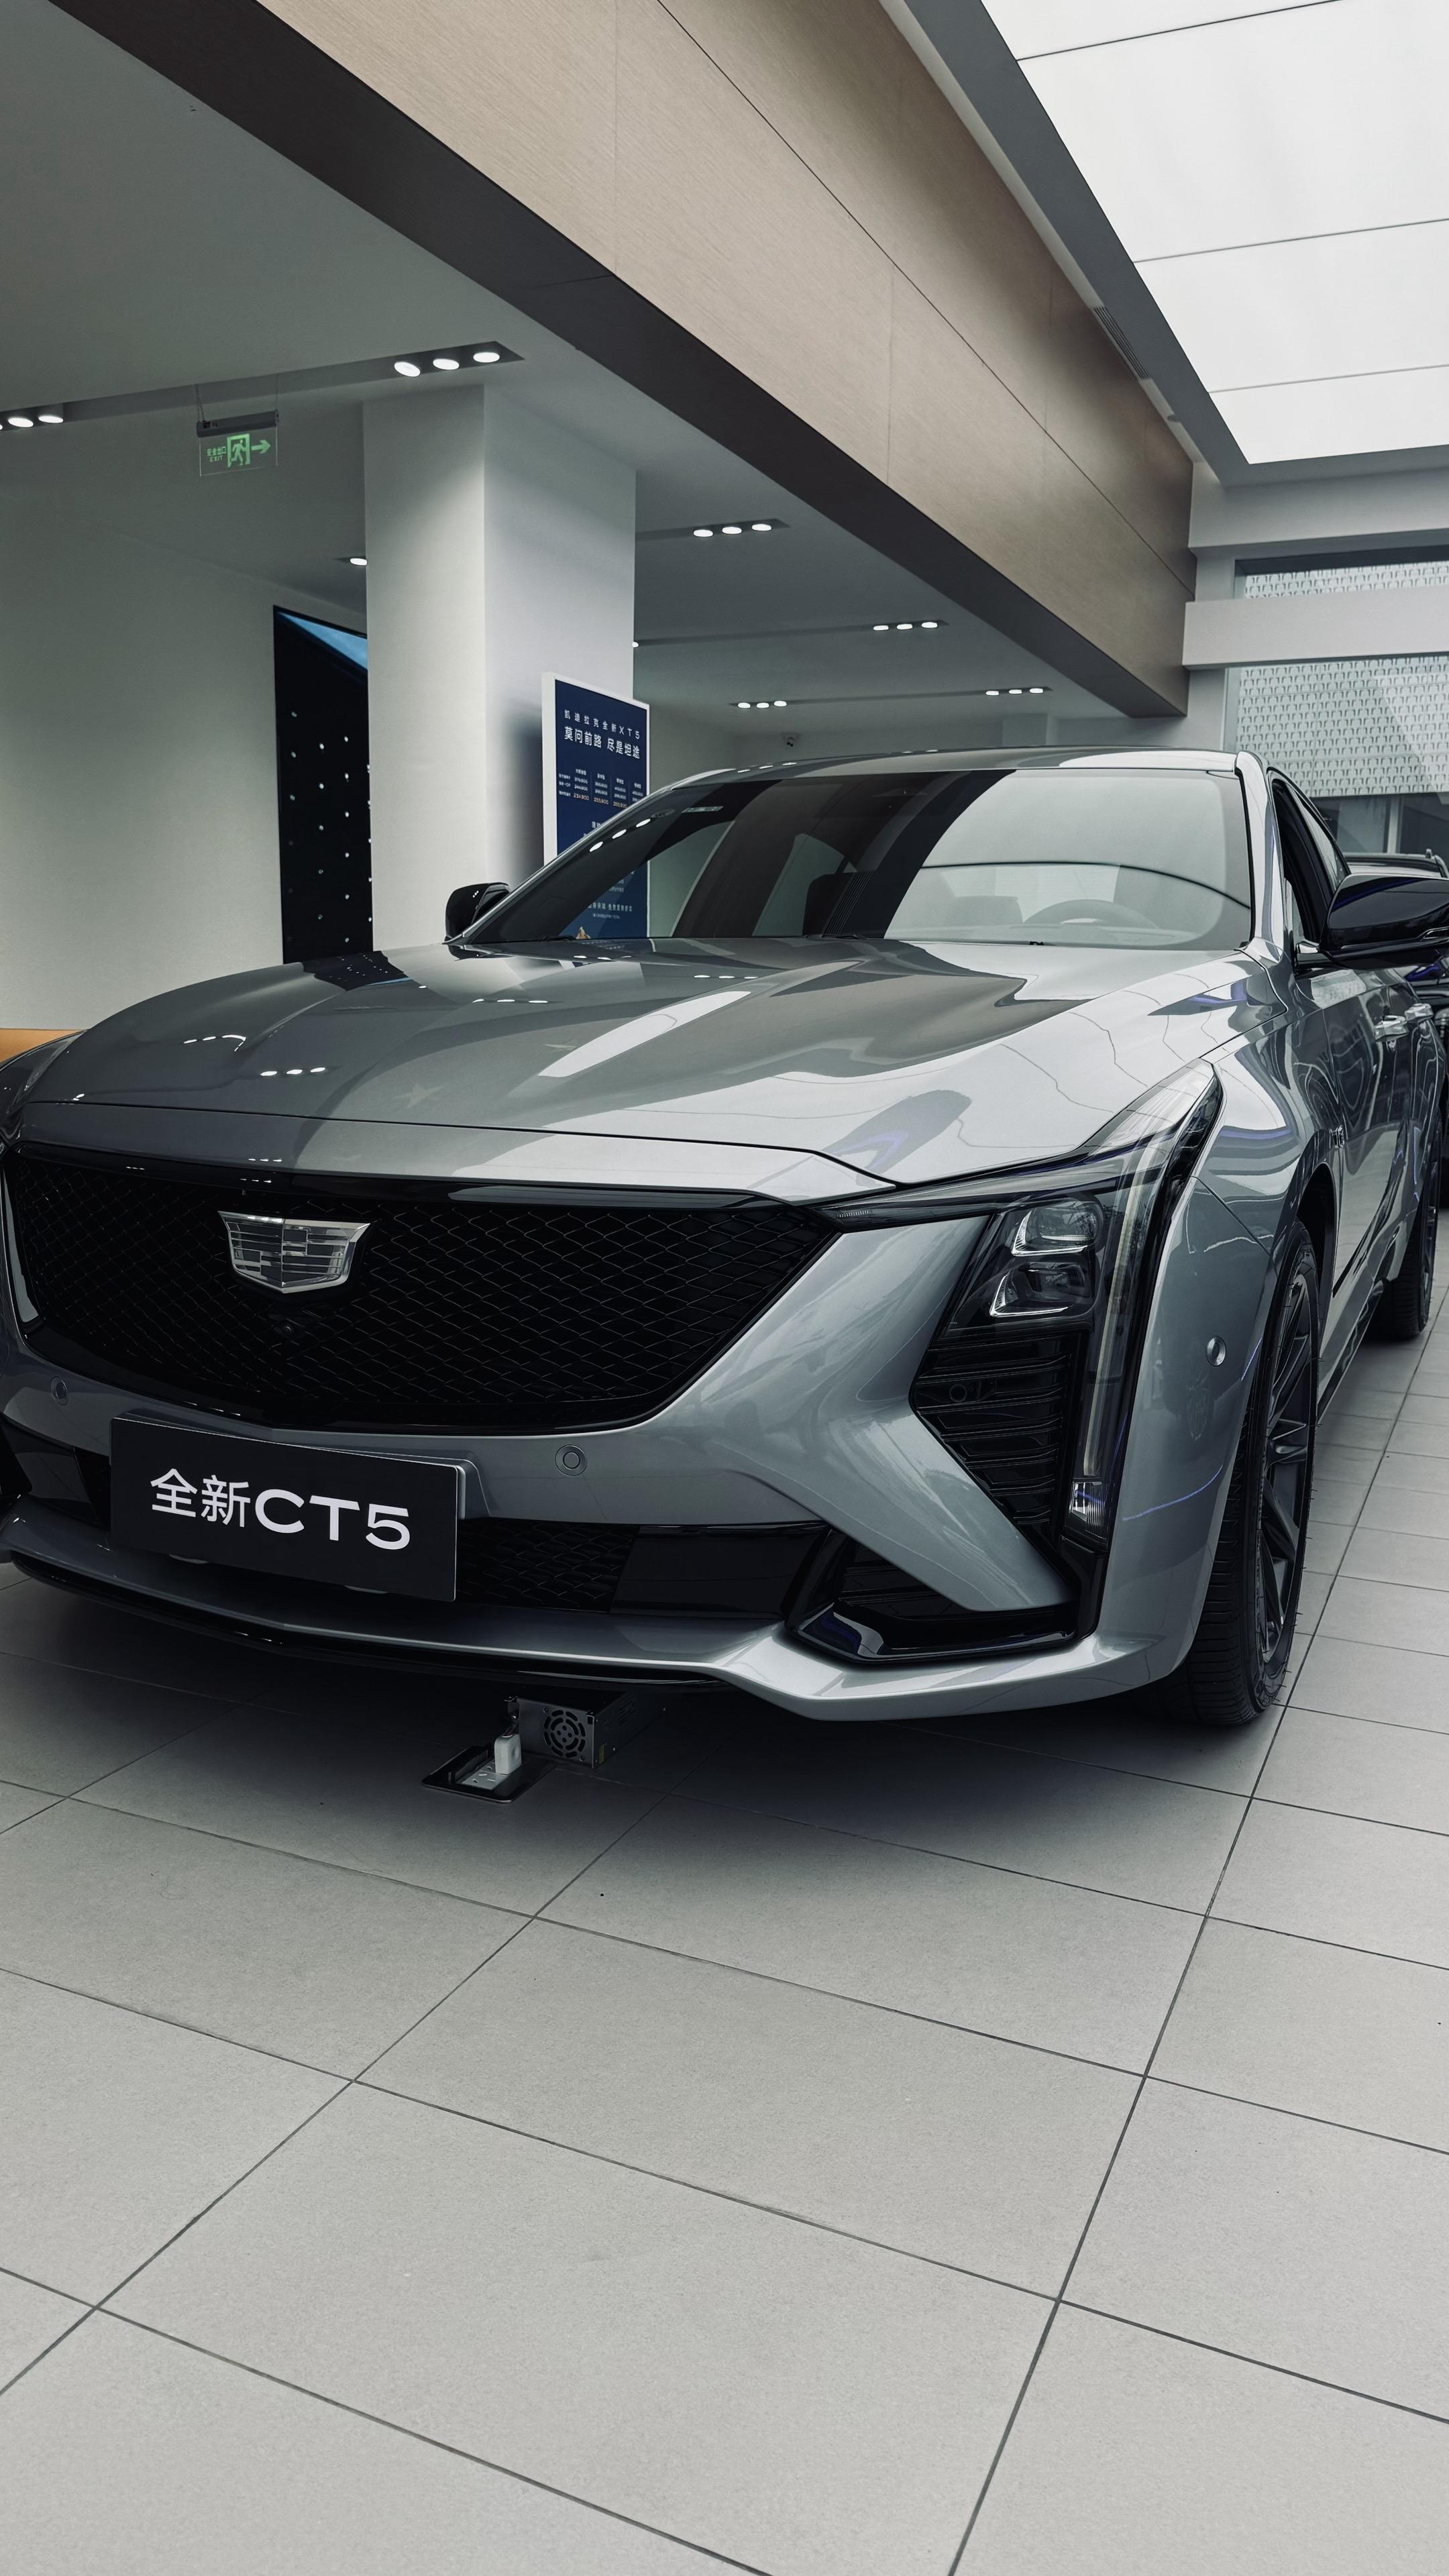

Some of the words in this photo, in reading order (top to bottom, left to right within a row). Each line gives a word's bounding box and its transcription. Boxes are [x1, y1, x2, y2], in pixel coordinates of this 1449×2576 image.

[564, 726, 601, 748] 莫问前路
[607, 738, 640, 759] 尽是坦途
[150, 1468, 411, 1550] 全新CT5
